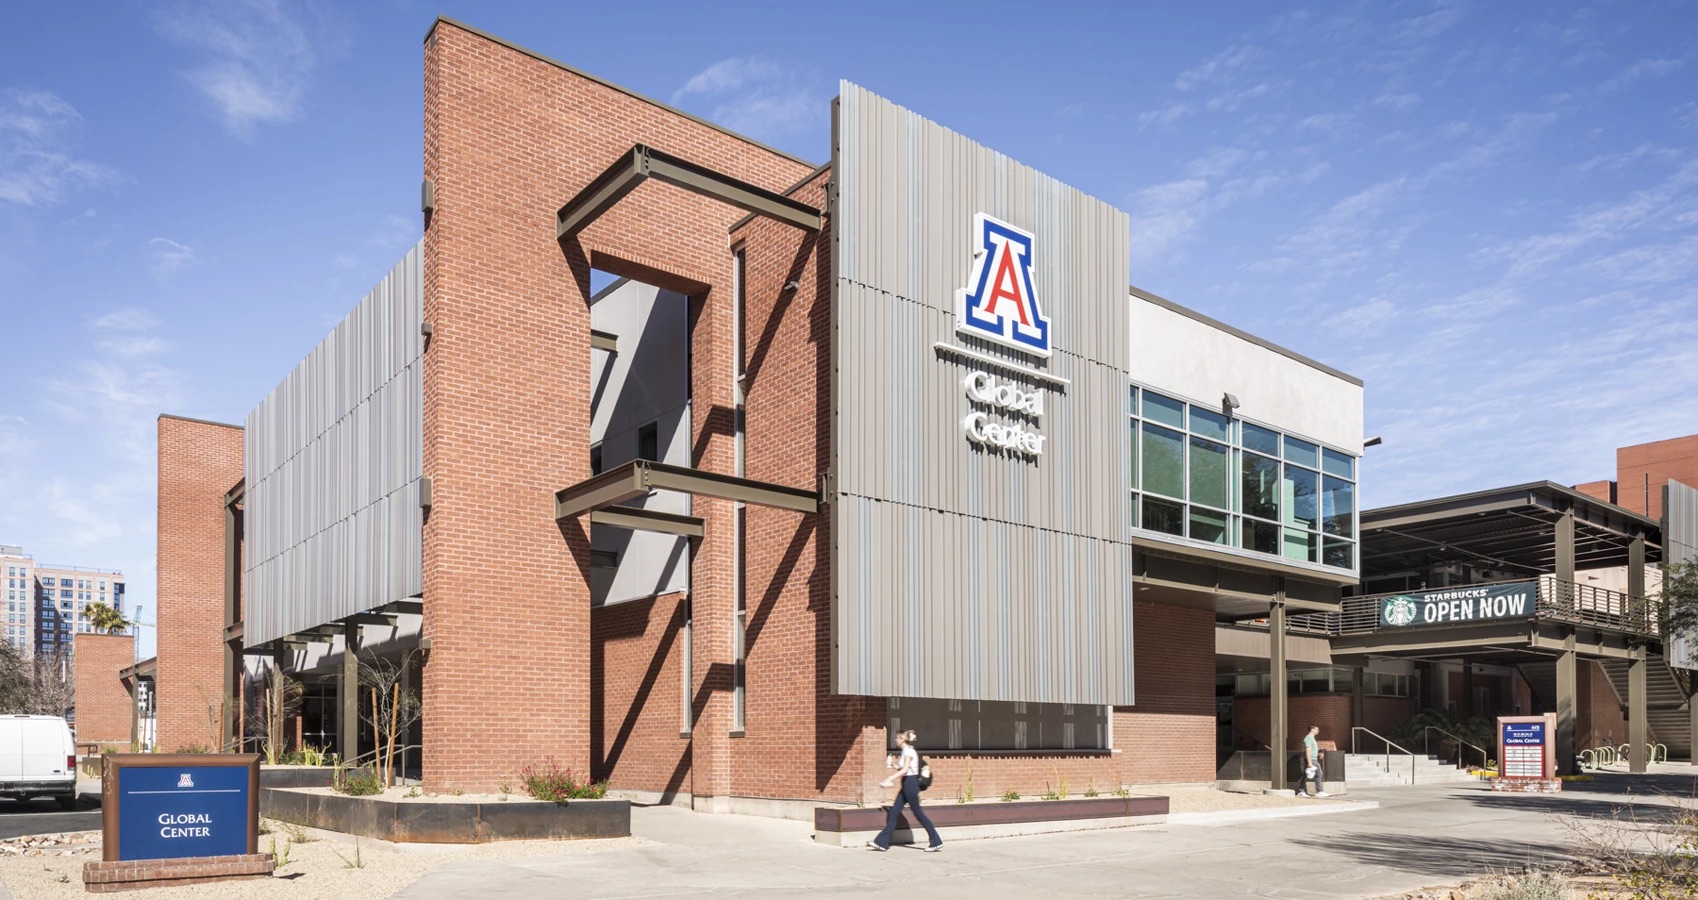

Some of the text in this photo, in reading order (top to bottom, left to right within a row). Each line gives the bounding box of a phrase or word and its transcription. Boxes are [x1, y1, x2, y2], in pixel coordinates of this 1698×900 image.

[956, 212, 1052, 358] A
[965, 371, 1044, 416] Global
[965, 412, 1045, 454] Center
[1424, 589, 1489, 602] STARBUCKS
[1424, 593, 1526, 623] OPEN NOW
[178, 774, 194, 787] A
[158, 813, 212, 825] GLOBAL
[160, 826, 210, 838] CENTER
